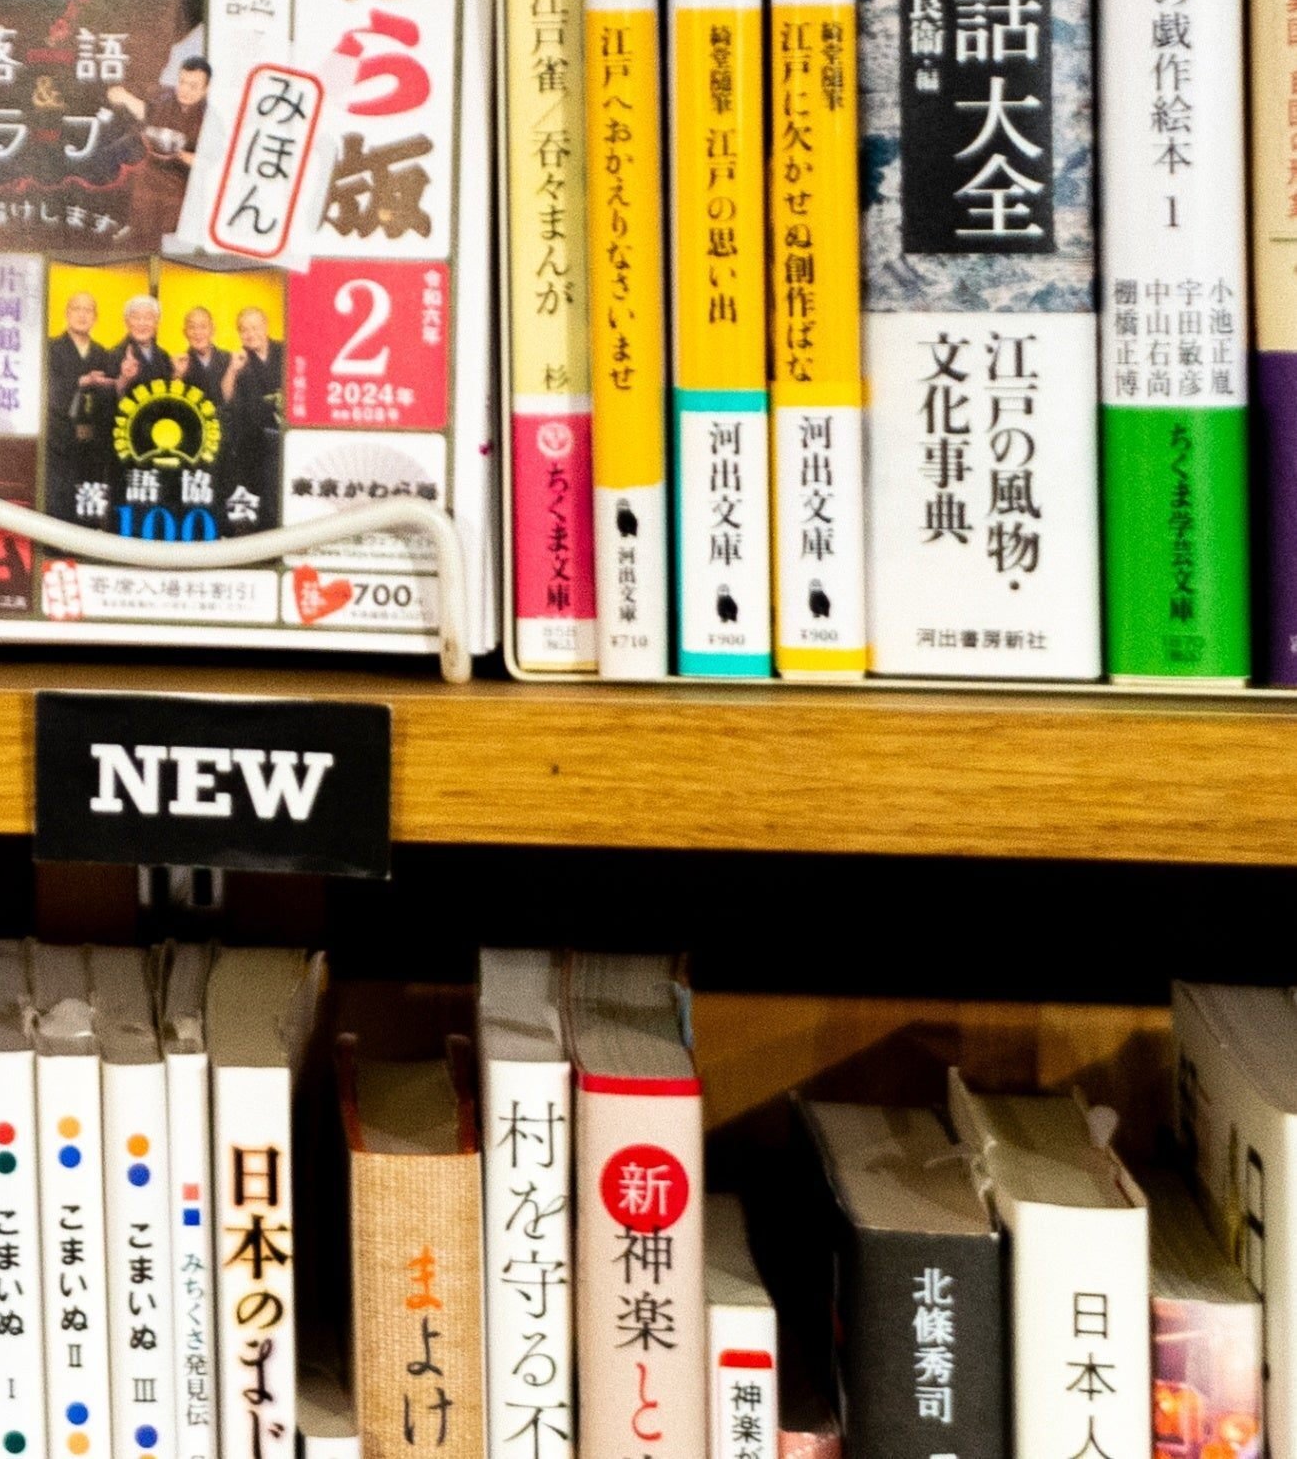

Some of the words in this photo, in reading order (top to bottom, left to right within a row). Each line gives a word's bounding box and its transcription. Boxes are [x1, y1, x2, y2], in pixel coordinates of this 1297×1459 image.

[228, 75, 308, 236] みほん
[599, 26, 636, 391] 江戸へおかえりなさいませ
[706, 127, 739, 325] 江戸の思い出
[780, 22, 815, 383] 江戸に欠かせぬ創作ばな
[1166, 195, 1181, 229] 1
[326, 382, 415, 407] 2024年
[329, 277, 392, 377] 2
[1112, 276, 1140, 398] 棚橋正博
[1144, 277, 1172, 398] 中山右尚
[1176, 276, 1203, 398] 宇田敏彦
[74, 467, 262, 524] 落語協会
[707, 420, 743, 568] 河出文庫
[797, 415, 835, 563] 河出文庫
[915, 330, 975, 546] 文化事典
[983, 330, 1043, 594] 江戸の風物・
[353, 583, 412, 608] 700
[544, 460, 572, 613] ちくま文庫
[1169, 422, 1197, 625] ちくま学芸文庫
[915, 626, 1048, 652] 河出書房新社
[90, 743, 334, 822] NEW
[616, 1162, 674, 1217] 新
[58, 1203, 89, 1332] こまいぬ
[127, 1221, 158, 1352] こまいぬ
[181, 1251, 210, 1427] みちくさ発見伝
[496, 1099, 570, 1459] 村を守る不
[611, 1225, 678, 1443] 神楽と
[402, 1244, 454, 1447] まよけ
[911, 1267, 958, 1425] 北條秀司
[1064, 1291, 1118, 1459] 日本人
